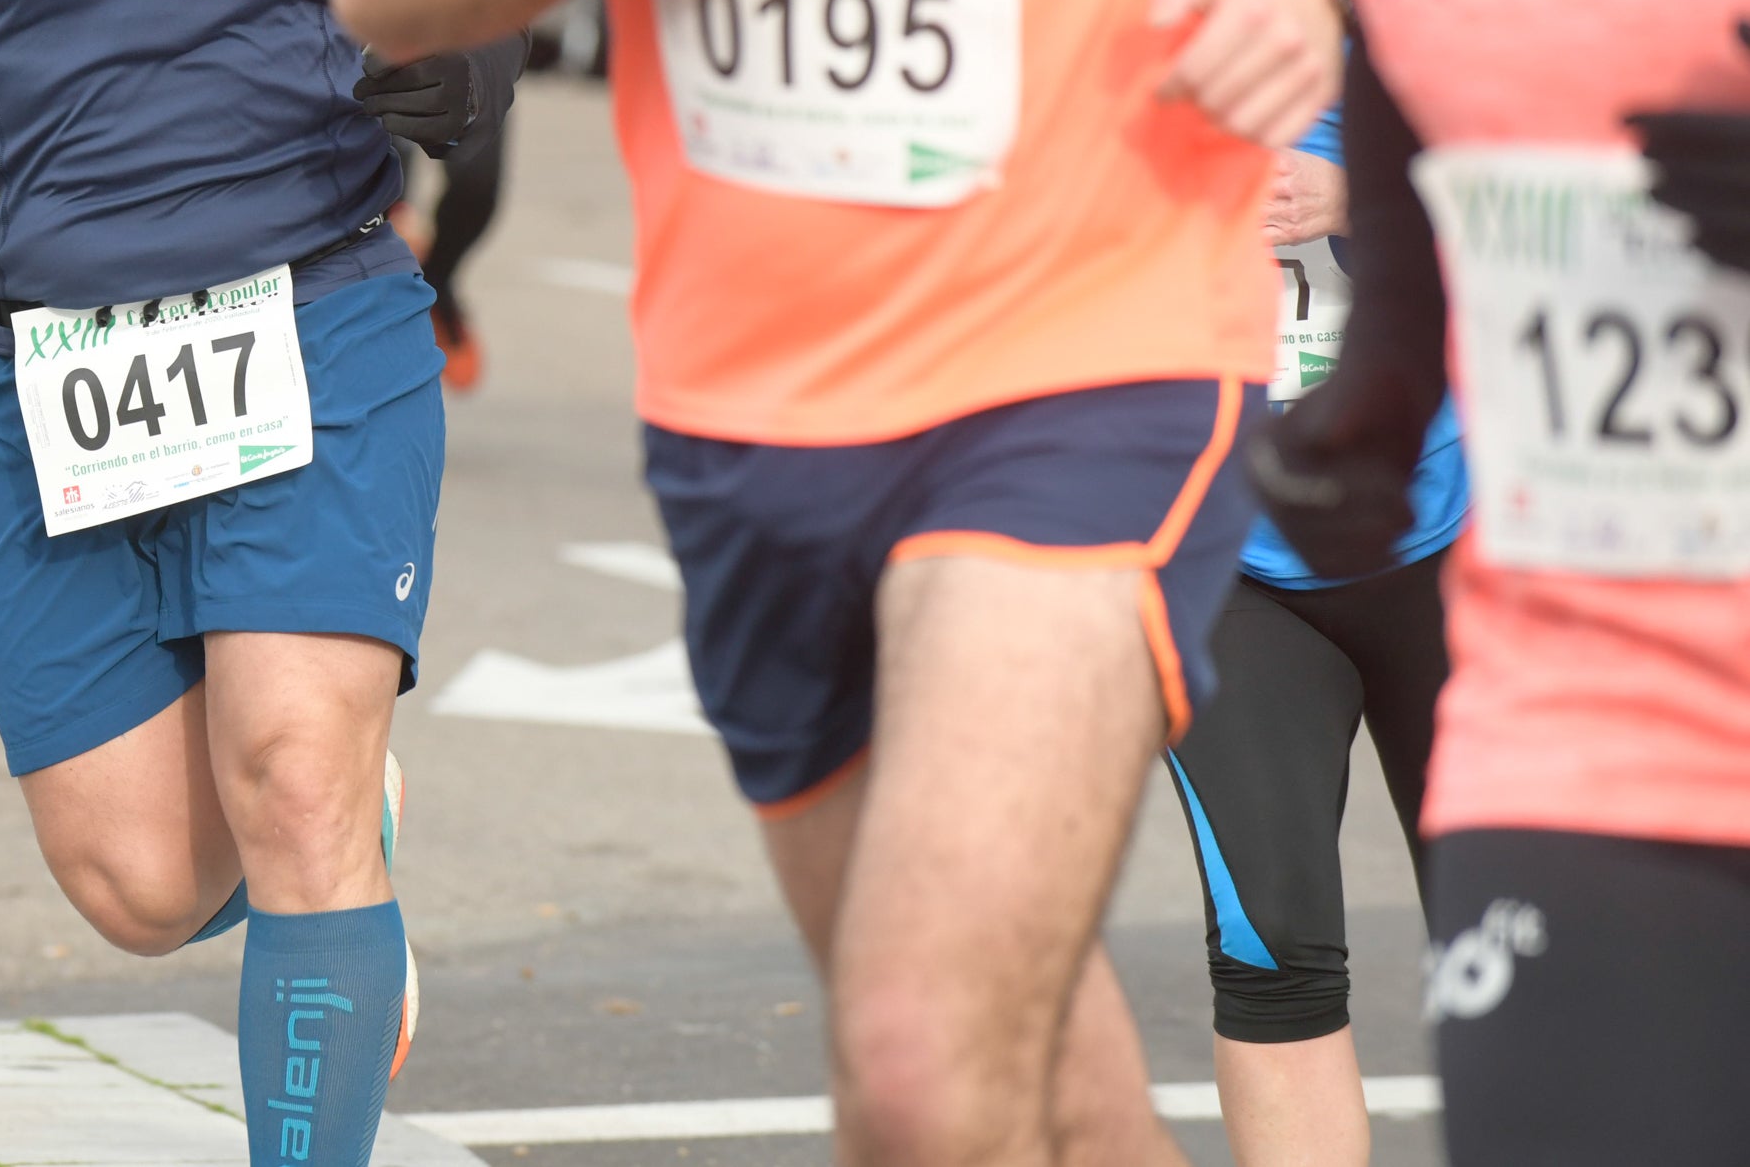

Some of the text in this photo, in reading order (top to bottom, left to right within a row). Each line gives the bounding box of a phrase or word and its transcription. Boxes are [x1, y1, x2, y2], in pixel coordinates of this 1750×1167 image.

[25, 316, 116, 366] XXIII
[127, 300, 202, 325] Carera
[207, 276, 281, 309] Popular
[1299, 331, 1313, 344] en
[62, 331, 256, 451] 0417
[1516, 305, 1750, 447] 123
[132, 452, 146, 463] en
[150, 446, 160, 460] el
[164, 439, 202, 457] barrio,
[206, 431, 235, 447] como
[240, 427, 253, 438] en
[54, 503, 95, 517] salesianos
[267, 977, 354, 1167] alenji
